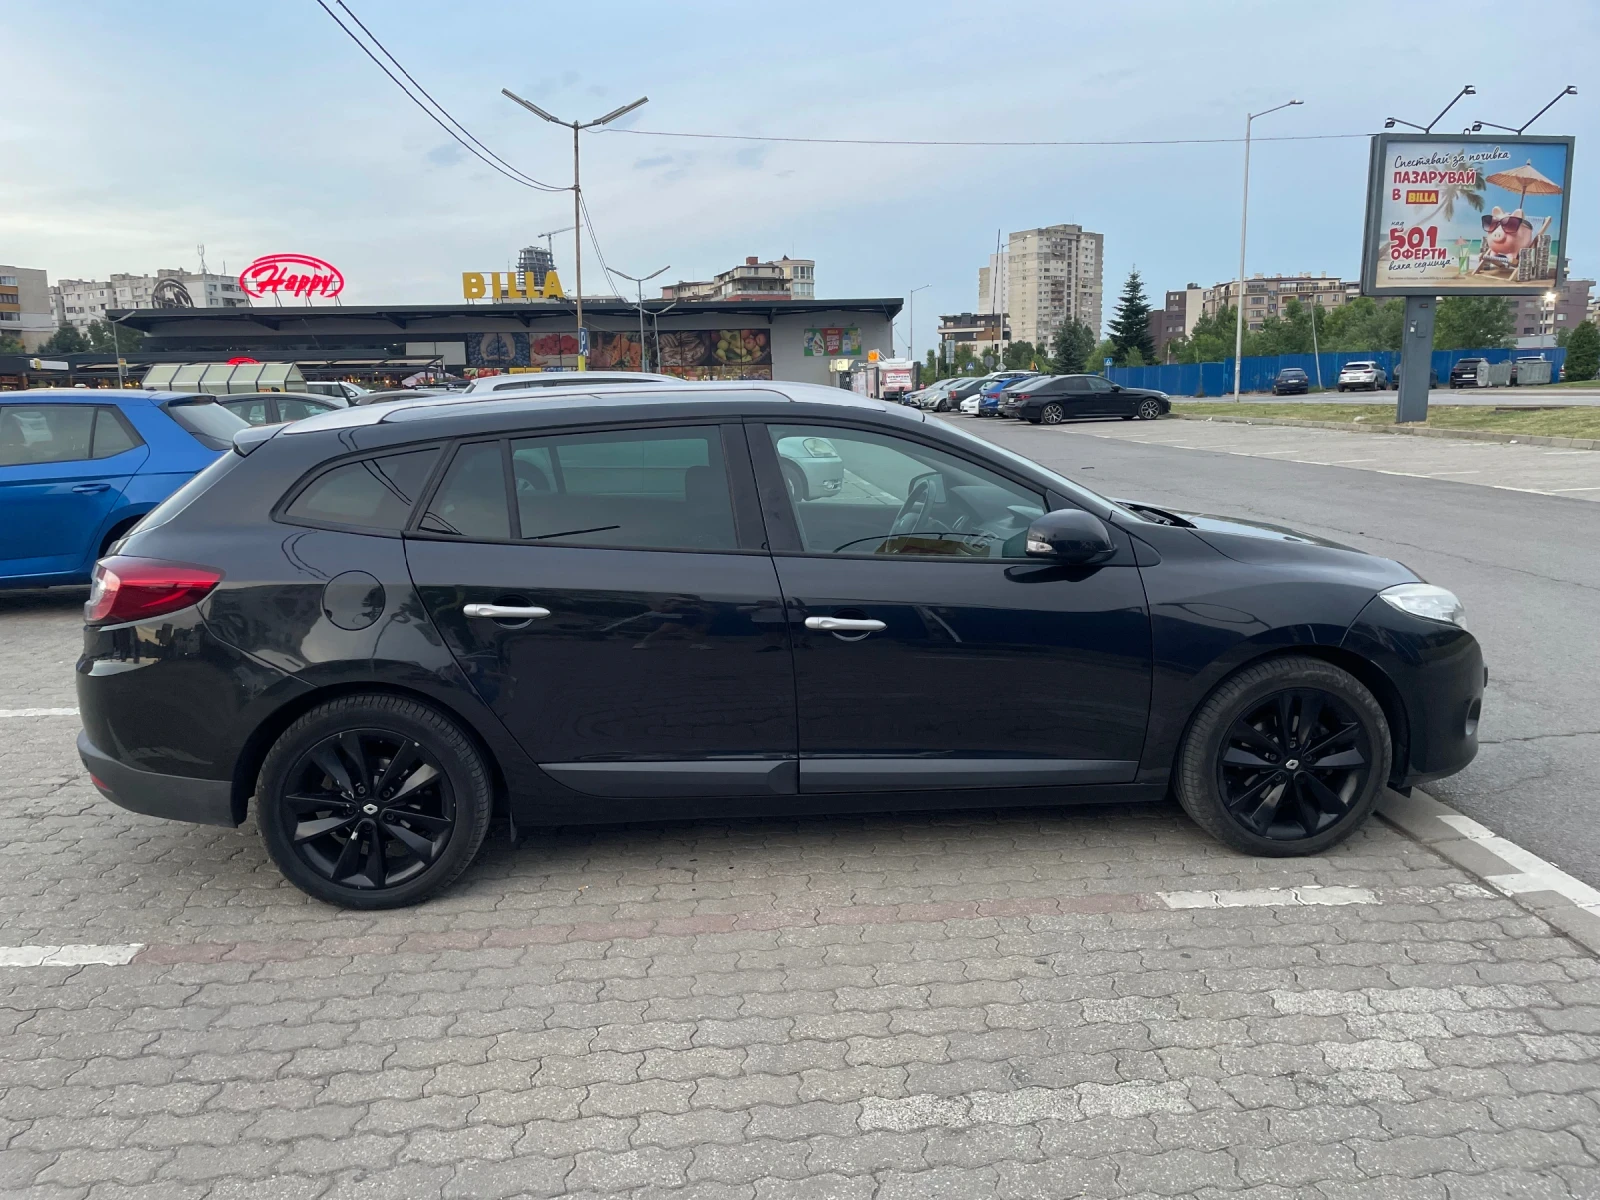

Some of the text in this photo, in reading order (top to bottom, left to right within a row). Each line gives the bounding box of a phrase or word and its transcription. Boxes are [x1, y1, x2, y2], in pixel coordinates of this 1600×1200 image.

[1395, 147, 1509, 168] Спестявай за почивка
[1394, 170, 1475, 184] ПАЗАРУВАЙ
[1392, 188, 1437, 203] В BILLA
[1391, 221, 1404, 231] над
[1390, 226, 1438, 249] 501
[1391, 248, 1447, 260] ОФЕРТИ
[1389, 260, 1411, 271] всяка
[251, 265, 334, 297] Happy
[463, 271, 563, 298] BILLA
